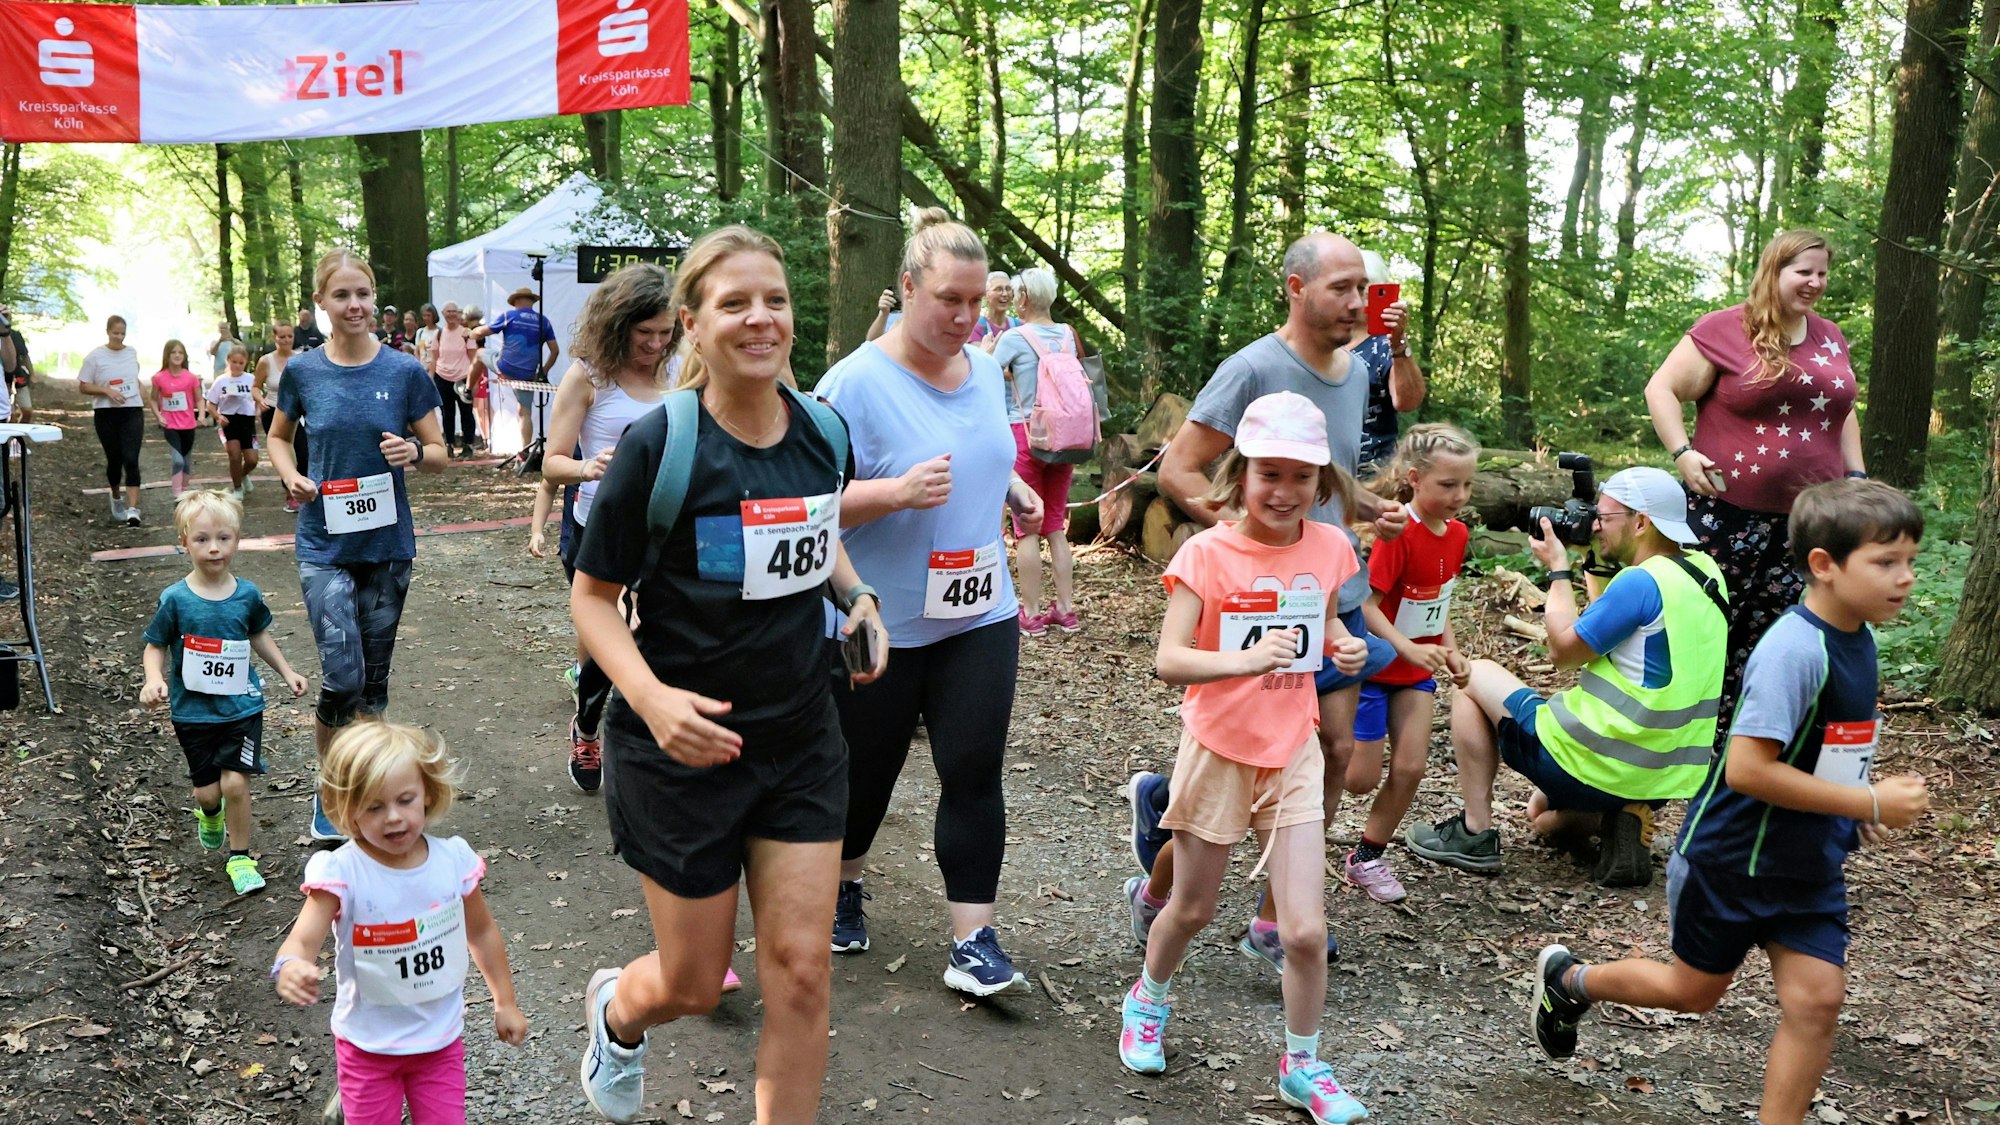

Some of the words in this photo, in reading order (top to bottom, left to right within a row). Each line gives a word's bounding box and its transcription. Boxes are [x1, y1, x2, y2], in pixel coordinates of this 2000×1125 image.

[296, 49, 404, 101] Ziel
[579, 67, 671, 85] Kreissparkasse
[610, 83, 639, 97] Köln
[18, 100, 118, 115] Kreissparkasse
[54, 117, 84, 129] Köln
[345, 497, 377, 515] 380
[767, 529, 829, 580] 483
[942, 572, 993, 607] 484
[1425, 604, 1442, 622] 71
[202, 660, 235, 678] 364
[394, 945, 445, 979] 188
[413, 980, 434, 990] Elina
